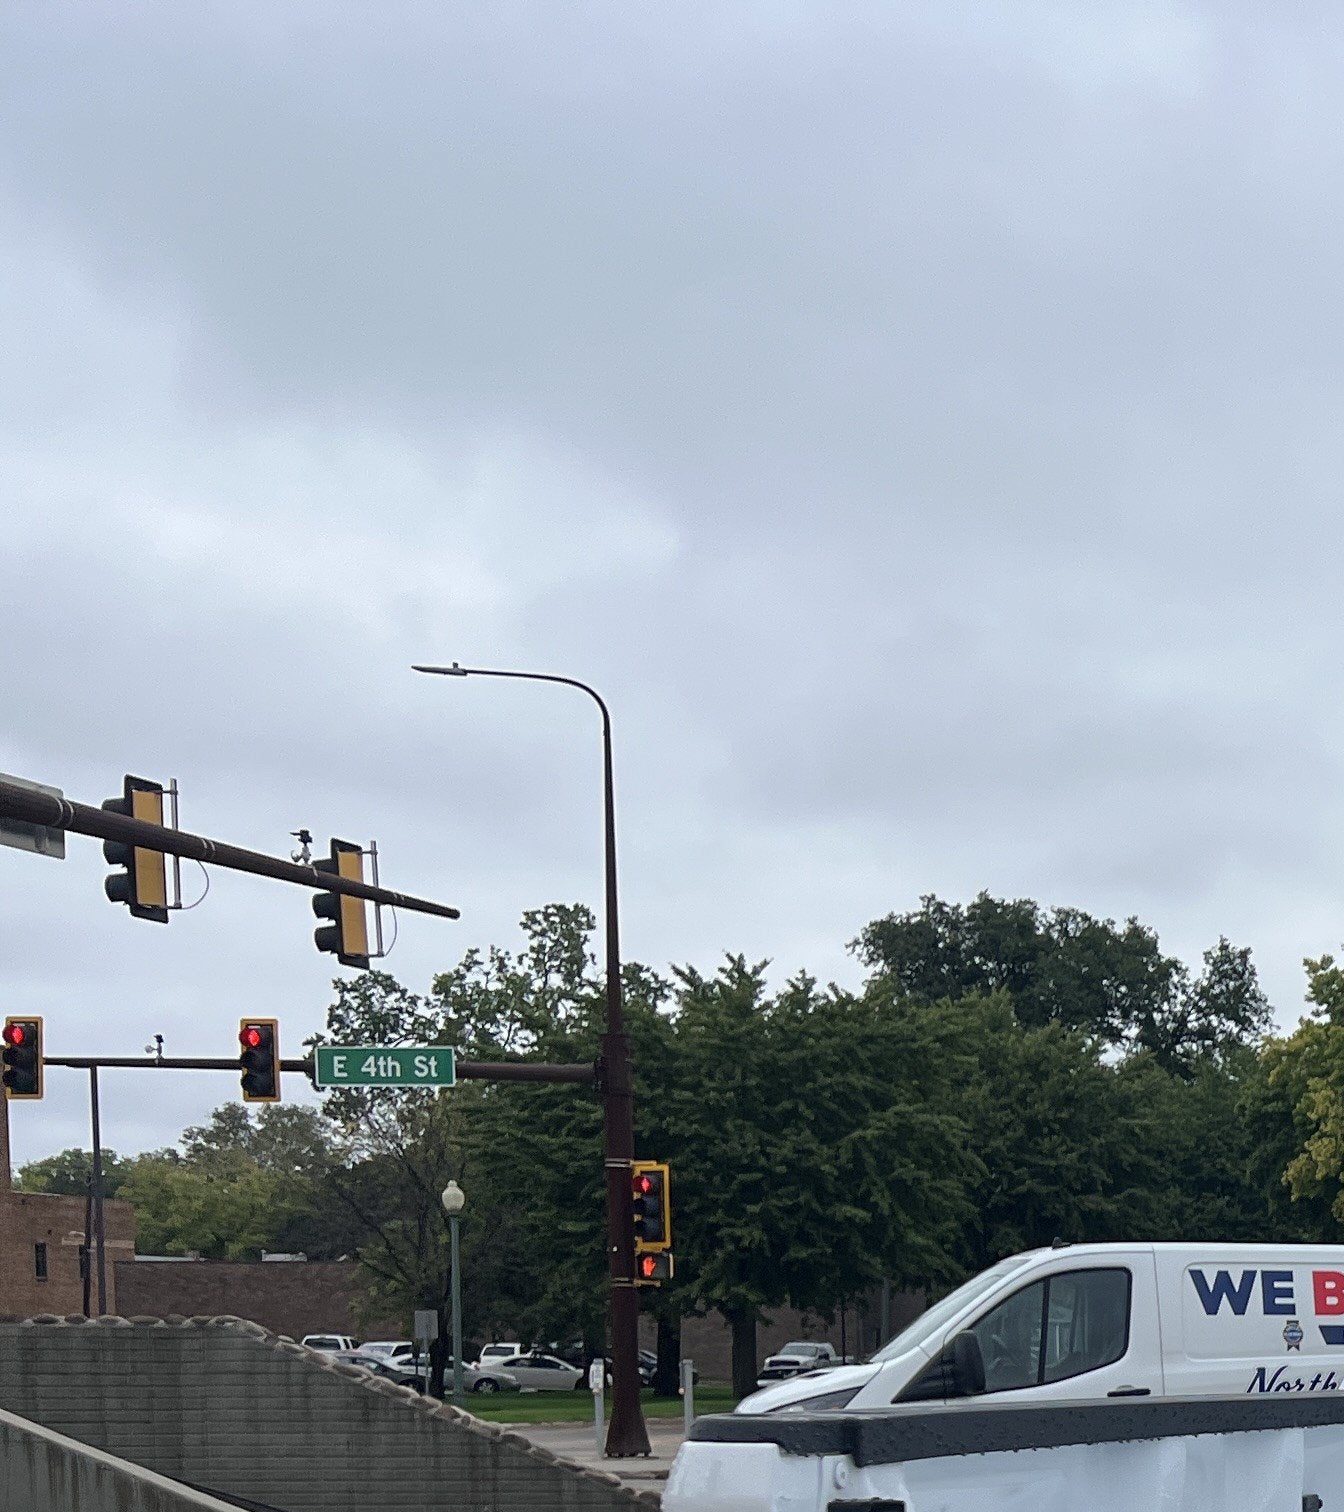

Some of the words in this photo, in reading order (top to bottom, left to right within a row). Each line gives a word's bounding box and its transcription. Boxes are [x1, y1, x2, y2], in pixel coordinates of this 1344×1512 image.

[333, 1055, 348, 1078] E
[360, 1055, 401, 1078] 4th
[413, 1055, 438, 1078] St
[1188, 1269, 1296, 1316] WE
